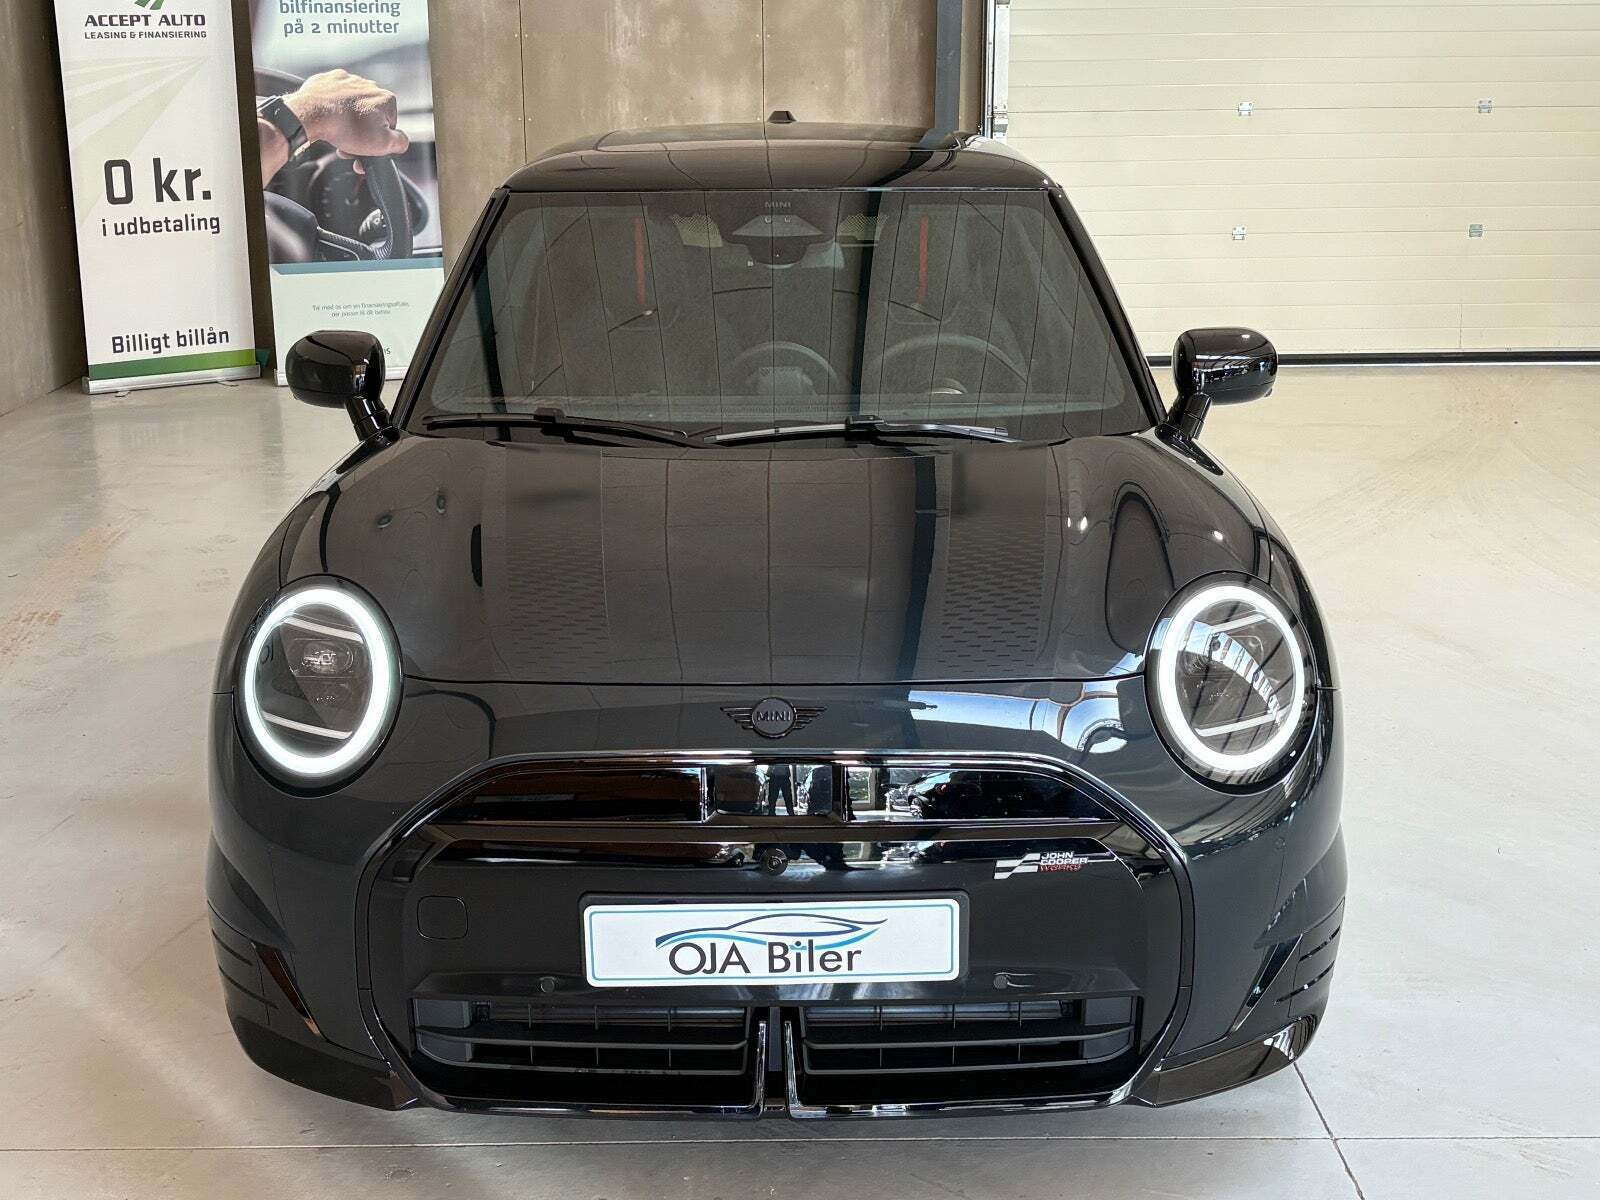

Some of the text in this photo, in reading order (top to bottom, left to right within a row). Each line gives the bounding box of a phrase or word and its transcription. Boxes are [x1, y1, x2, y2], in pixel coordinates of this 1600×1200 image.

[279, 0, 401, 17] bilfinansiering
[84, 14, 206, 27] ACCEPT AUTO
[283, 18, 399, 37] på 2 minutter
[84, 30, 207, 39] LEASING & FINANSIERING
[103, 157, 212, 205] 0 kr.
[101, 213, 221, 237] i udbetaling
[111, 327, 230, 355] Billigt billån
[757, 711, 791, 721] MINI
[1040, 864, 1082, 872] WORKS
[668, 939, 862, 975] OJA Biler
